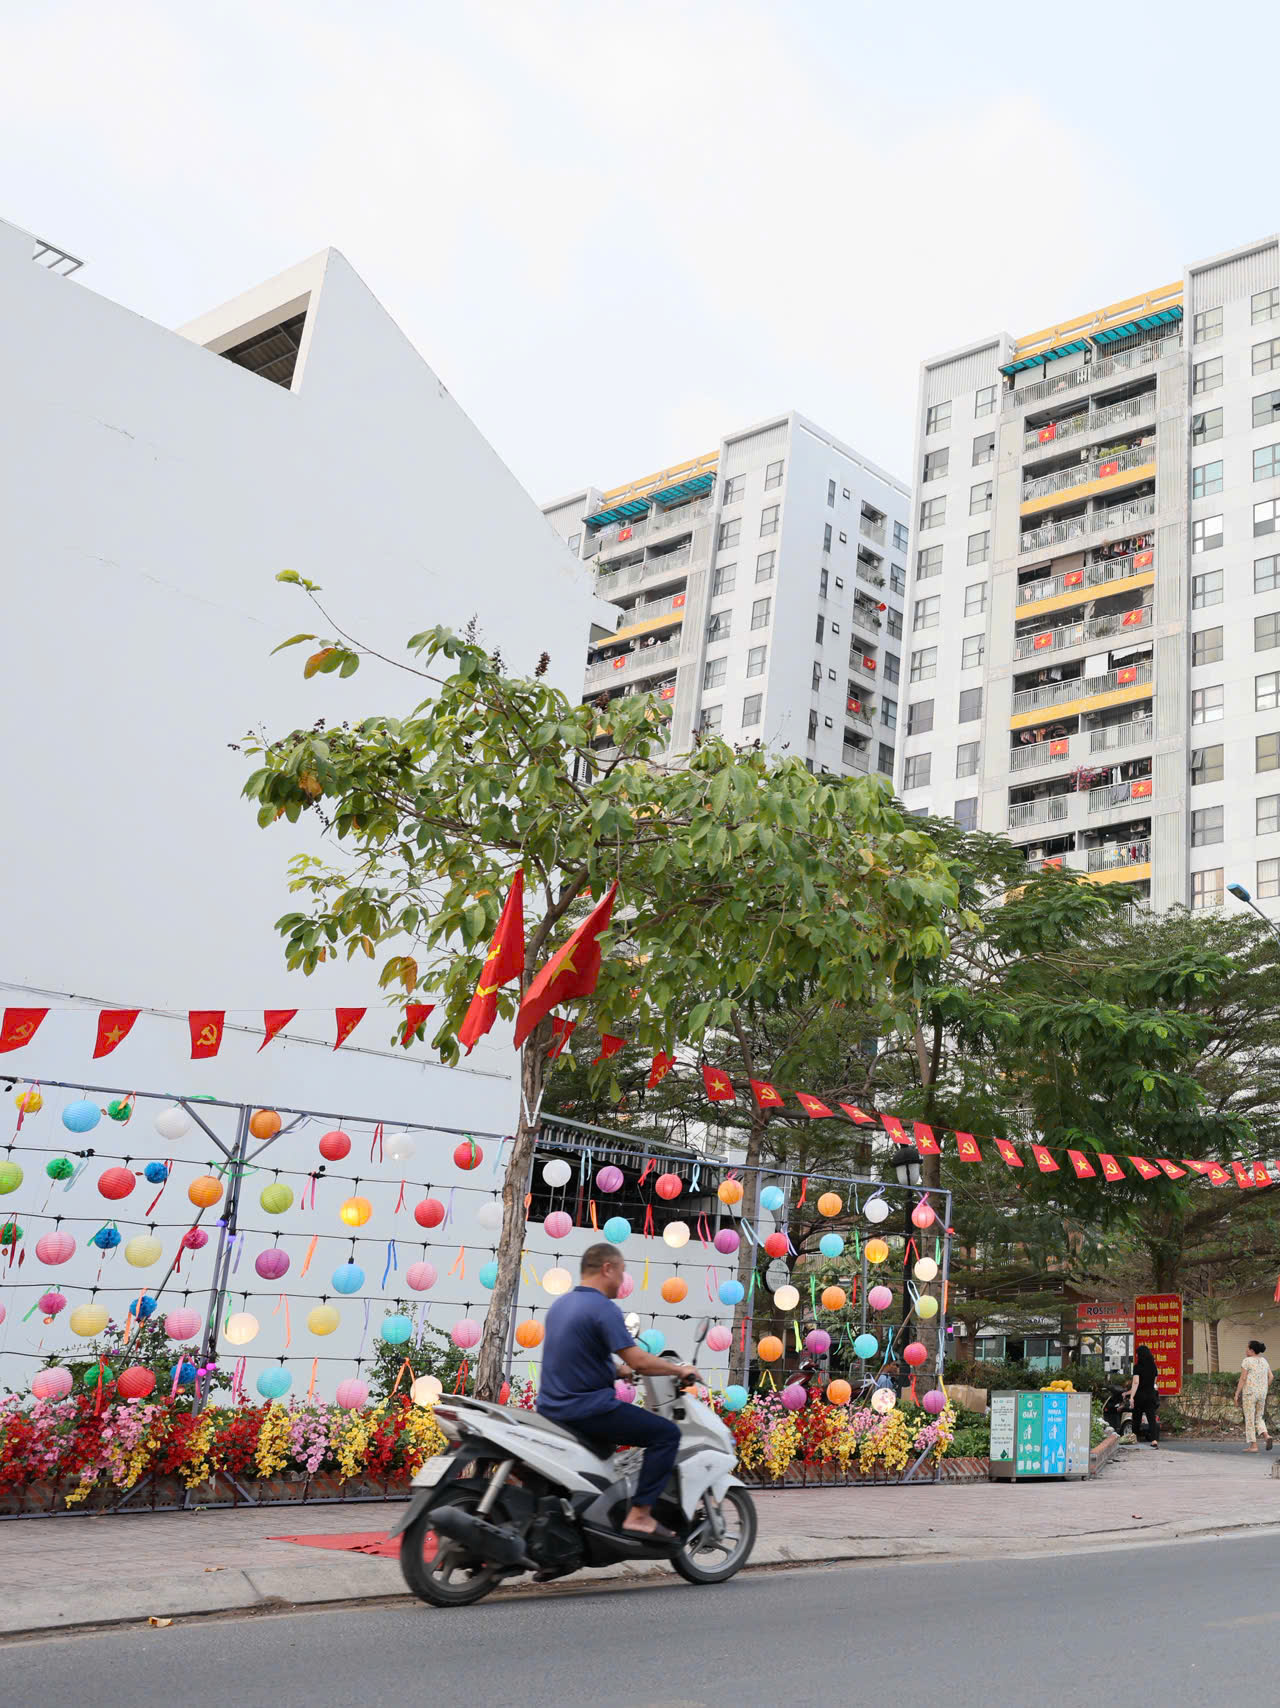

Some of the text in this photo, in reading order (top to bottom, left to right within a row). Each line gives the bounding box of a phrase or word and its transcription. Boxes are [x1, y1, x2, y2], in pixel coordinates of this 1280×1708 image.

[1156, 1353, 1167, 1361] Nam
[1165, 1379, 1177, 1388] minh
[1022, 1408, 1038, 1419] GIẤY
